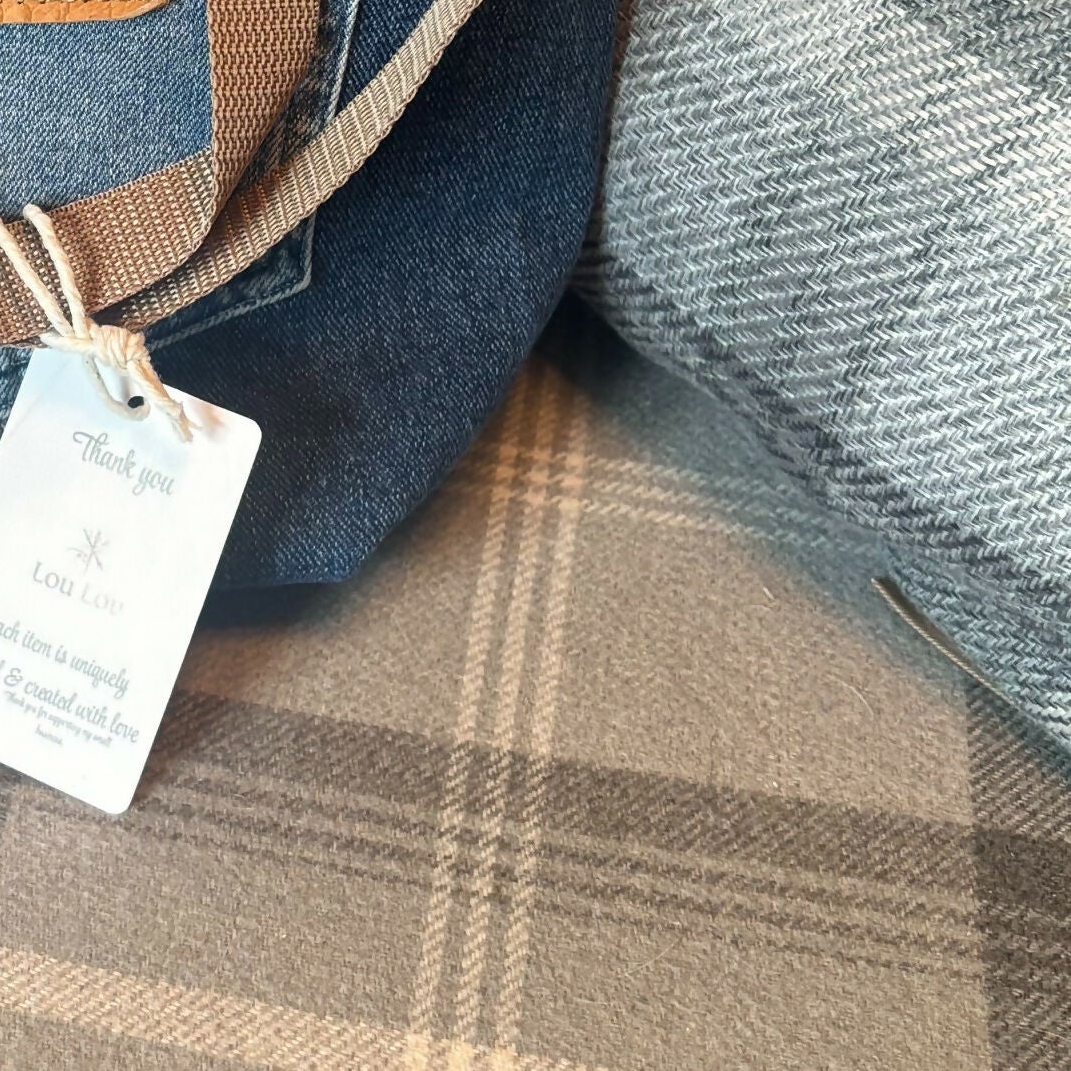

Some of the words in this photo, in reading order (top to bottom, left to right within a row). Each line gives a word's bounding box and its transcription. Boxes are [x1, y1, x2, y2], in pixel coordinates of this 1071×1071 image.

[72, 431, 137, 479] Thank
[131, 467, 175, 496] you
[32, 561, 75, 597] Lou
[22, 630, 54, 659] item
[55, 645, 68, 664] is
[69, 656, 130, 699] uniquely
[3, 667, 24, 687] &
[24, 679, 78, 713] created
[75, 702, 108, 729] with
[109, 712, 141, 743] love
